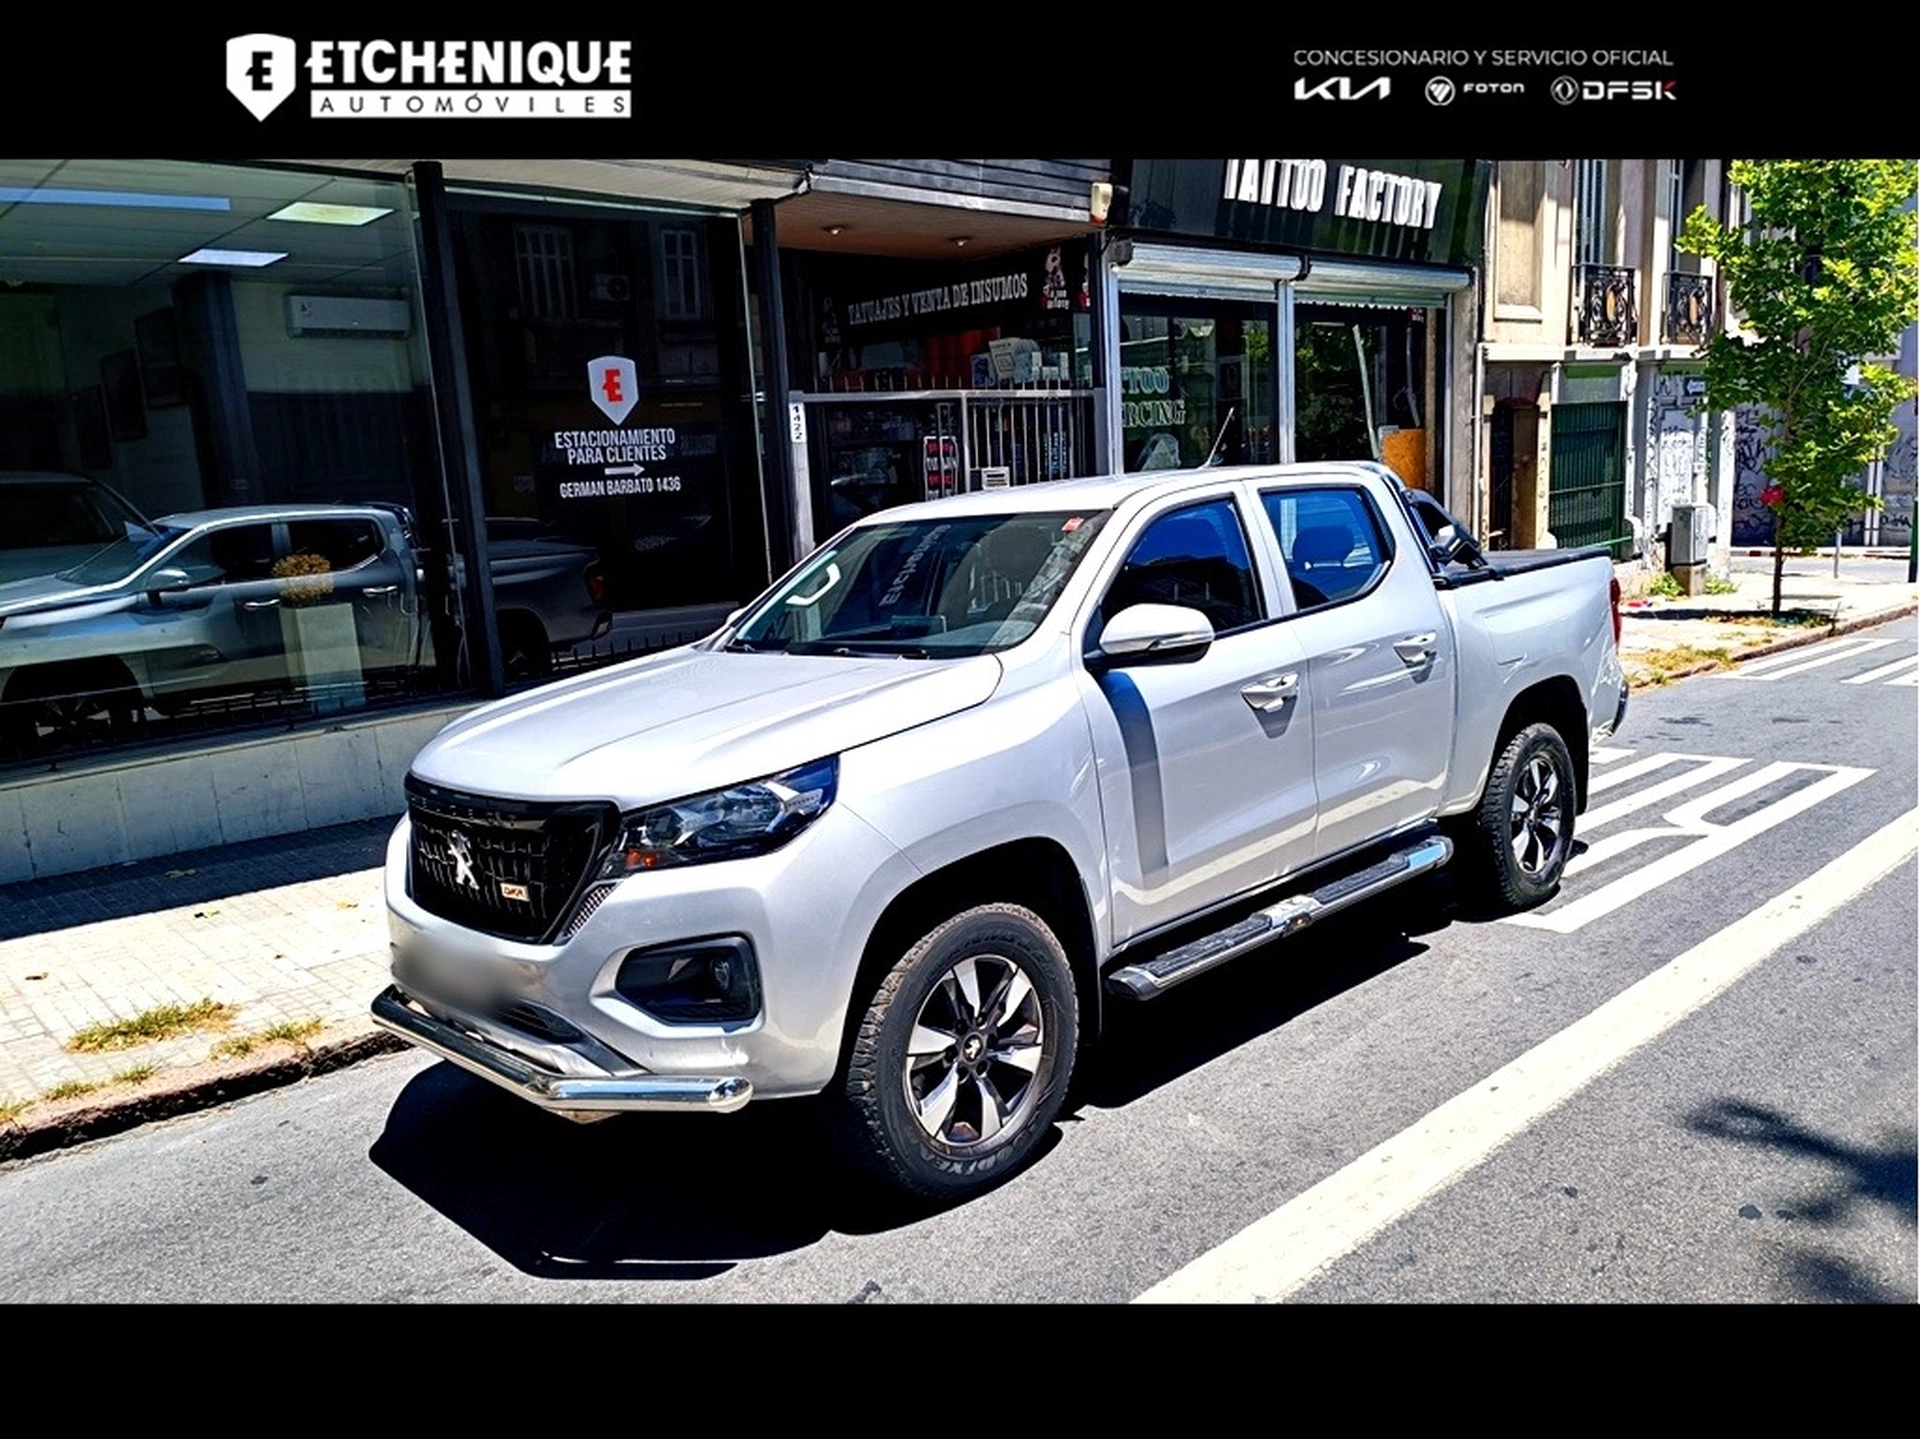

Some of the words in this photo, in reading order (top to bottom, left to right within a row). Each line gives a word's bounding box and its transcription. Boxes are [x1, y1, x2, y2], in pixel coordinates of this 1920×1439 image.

[1224, 159, 1327, 212] TATTOO
[1334, 165, 1442, 229] FACTORY
[848, 295, 901, 325] TATUAJES
[902, 293, 910, 316] Y
[911, 286, 951, 313] VENTA
[953, 284, 969, 306] DE
[971, 273, 1028, 304] INSUMOS
[555, 428, 675, 448] ESTACIONAMIENTO
[568, 446, 604, 465] PARA
[606, 445, 667, 463] CLIENTES
[559, 482, 605, 498] GERMAN
[607, 478, 653, 495] BARBATO
[656, 477, 681, 492] 1436
